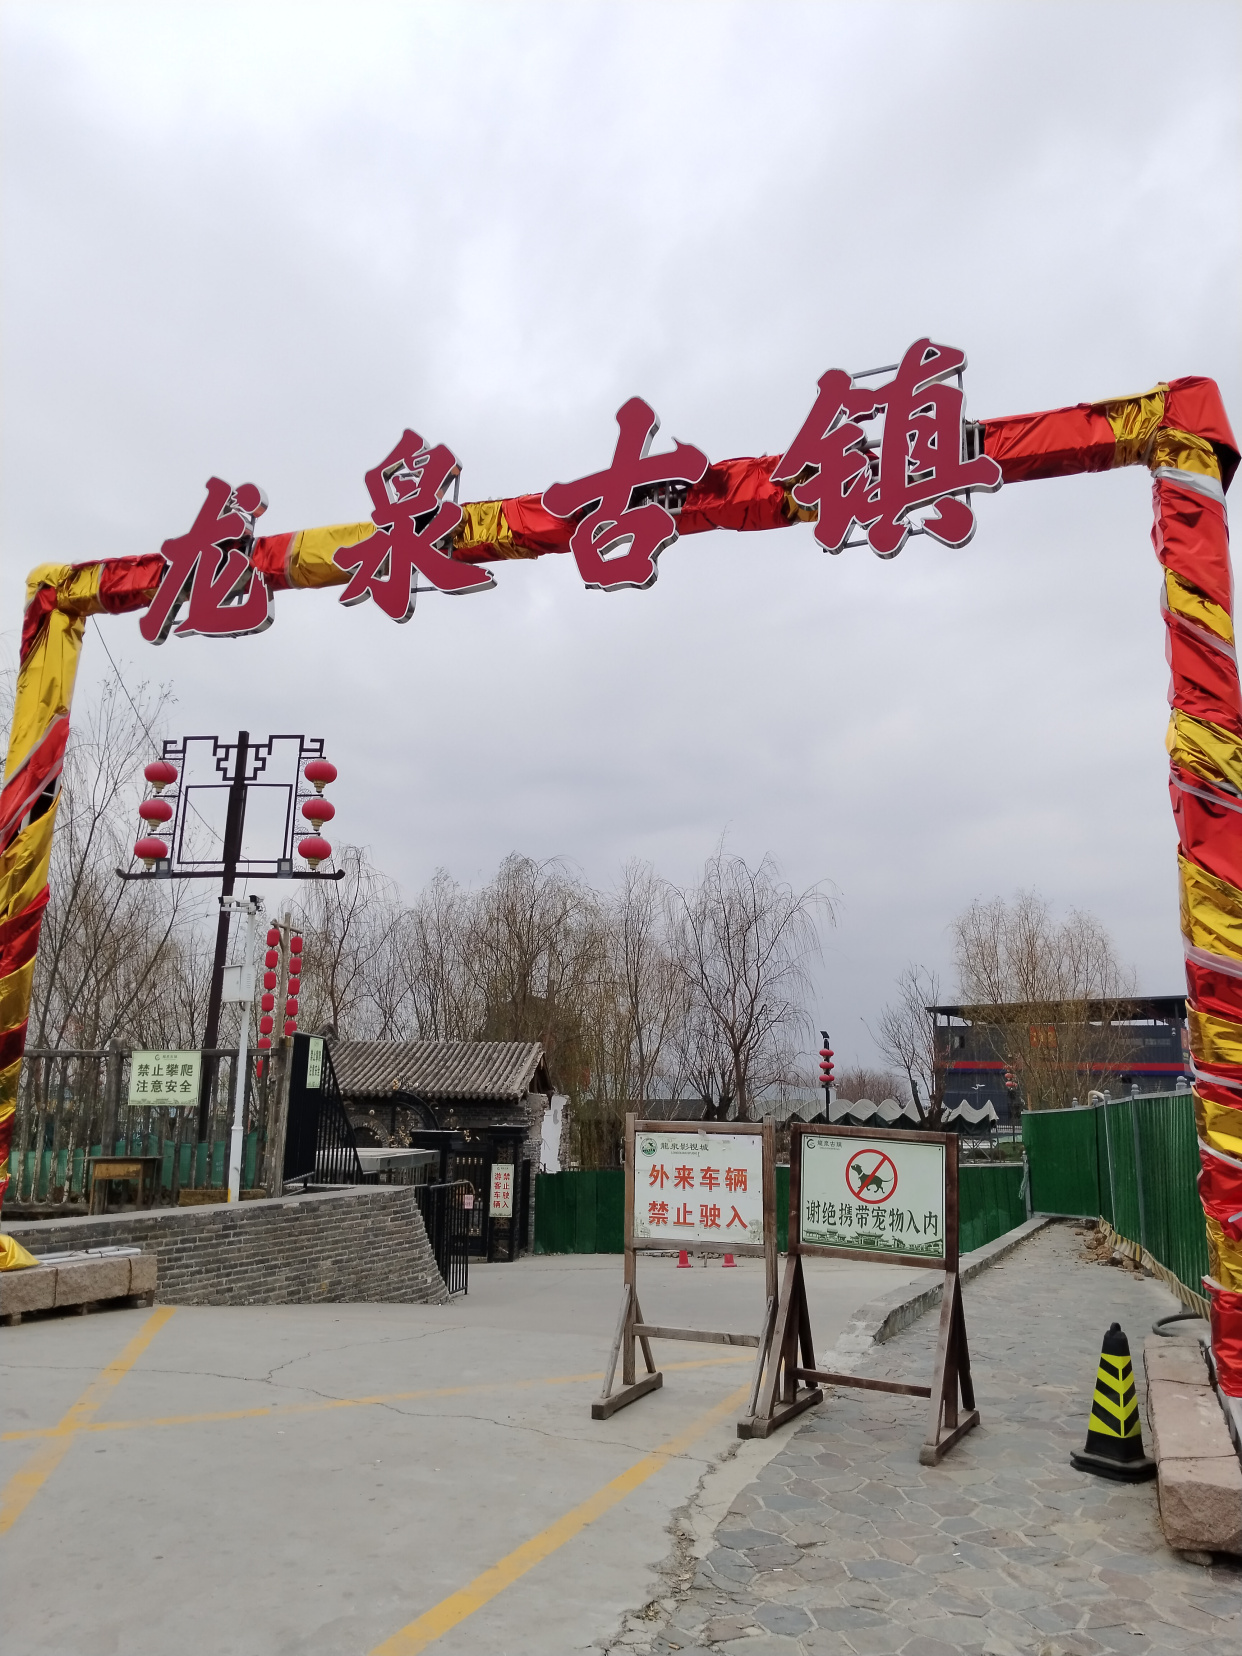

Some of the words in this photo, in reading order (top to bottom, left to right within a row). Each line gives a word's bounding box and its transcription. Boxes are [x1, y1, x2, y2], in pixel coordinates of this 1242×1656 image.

[139, 337, 1003, 645] 龙泉古镇
[136, 1079, 192, 1093] 注意安全
[137, 1063, 193, 1077] 禁止攀爬
[493, 1172, 502, 1208] 游客车辆
[502, 1172, 510, 1208] 禁止驶入
[648, 1163, 748, 1193] 外来车辆
[648, 1199, 748, 1230] 禁止驶入
[806, 1199, 939, 1237] 谢绝携带宠物入内
